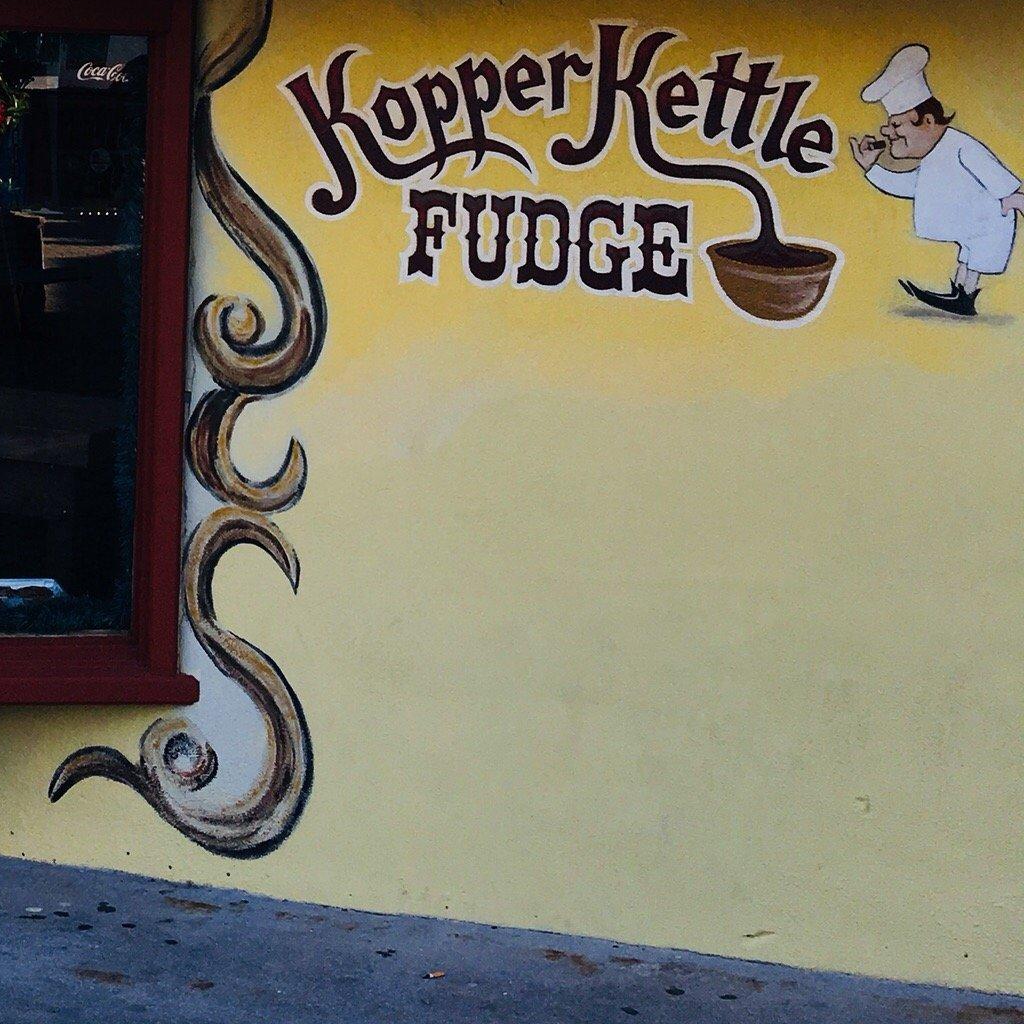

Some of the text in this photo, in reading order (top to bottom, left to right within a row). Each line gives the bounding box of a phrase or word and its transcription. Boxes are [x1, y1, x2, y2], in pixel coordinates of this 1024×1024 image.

[285, 23, 835, 216] Kopper Kettle
[408, 189, 689, 297] FUDGE
